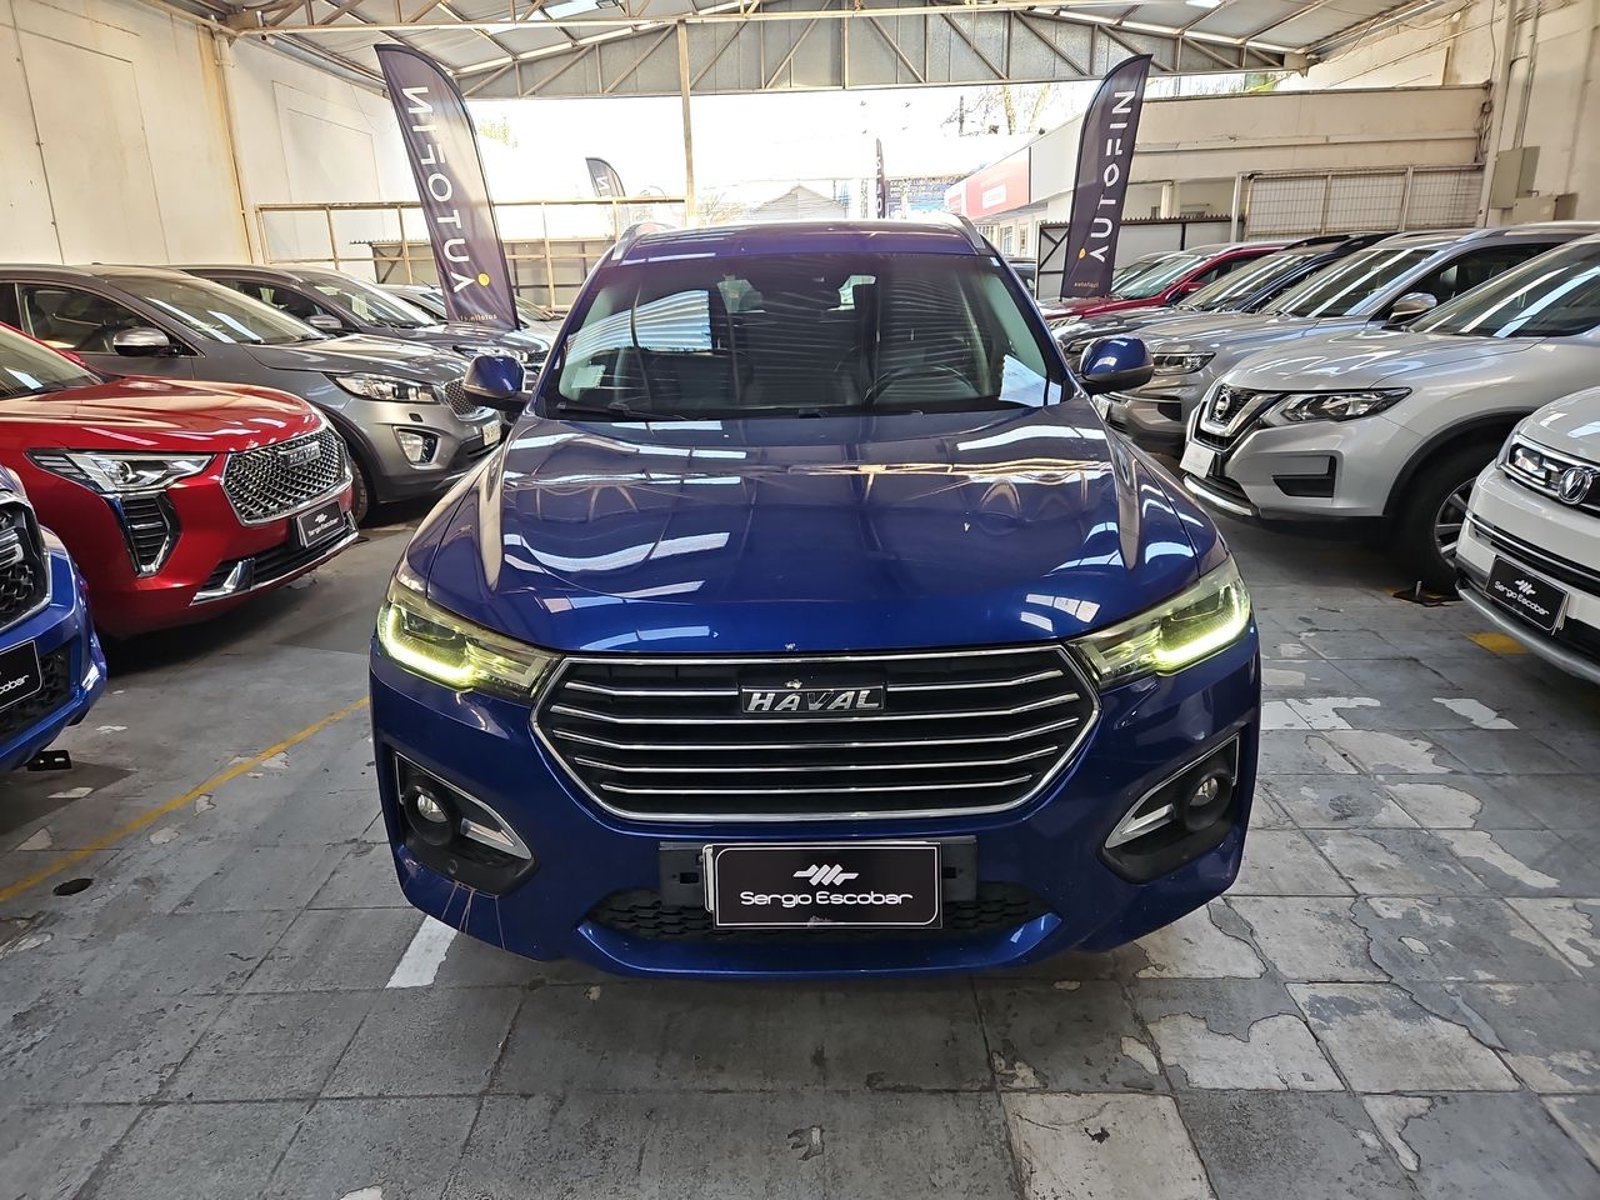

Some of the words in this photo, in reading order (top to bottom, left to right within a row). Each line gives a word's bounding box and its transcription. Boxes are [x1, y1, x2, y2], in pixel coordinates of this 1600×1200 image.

[1088, 89, 1136, 263] AUTOFIN
[1494, 580, 1518, 599] Sergio
[1517, 593, 1550, 615] Escobar
[747, 689, 880, 711] HAVAL
[739, 890, 812, 909] Sergio
[815, 890, 914, 906] Escobar
